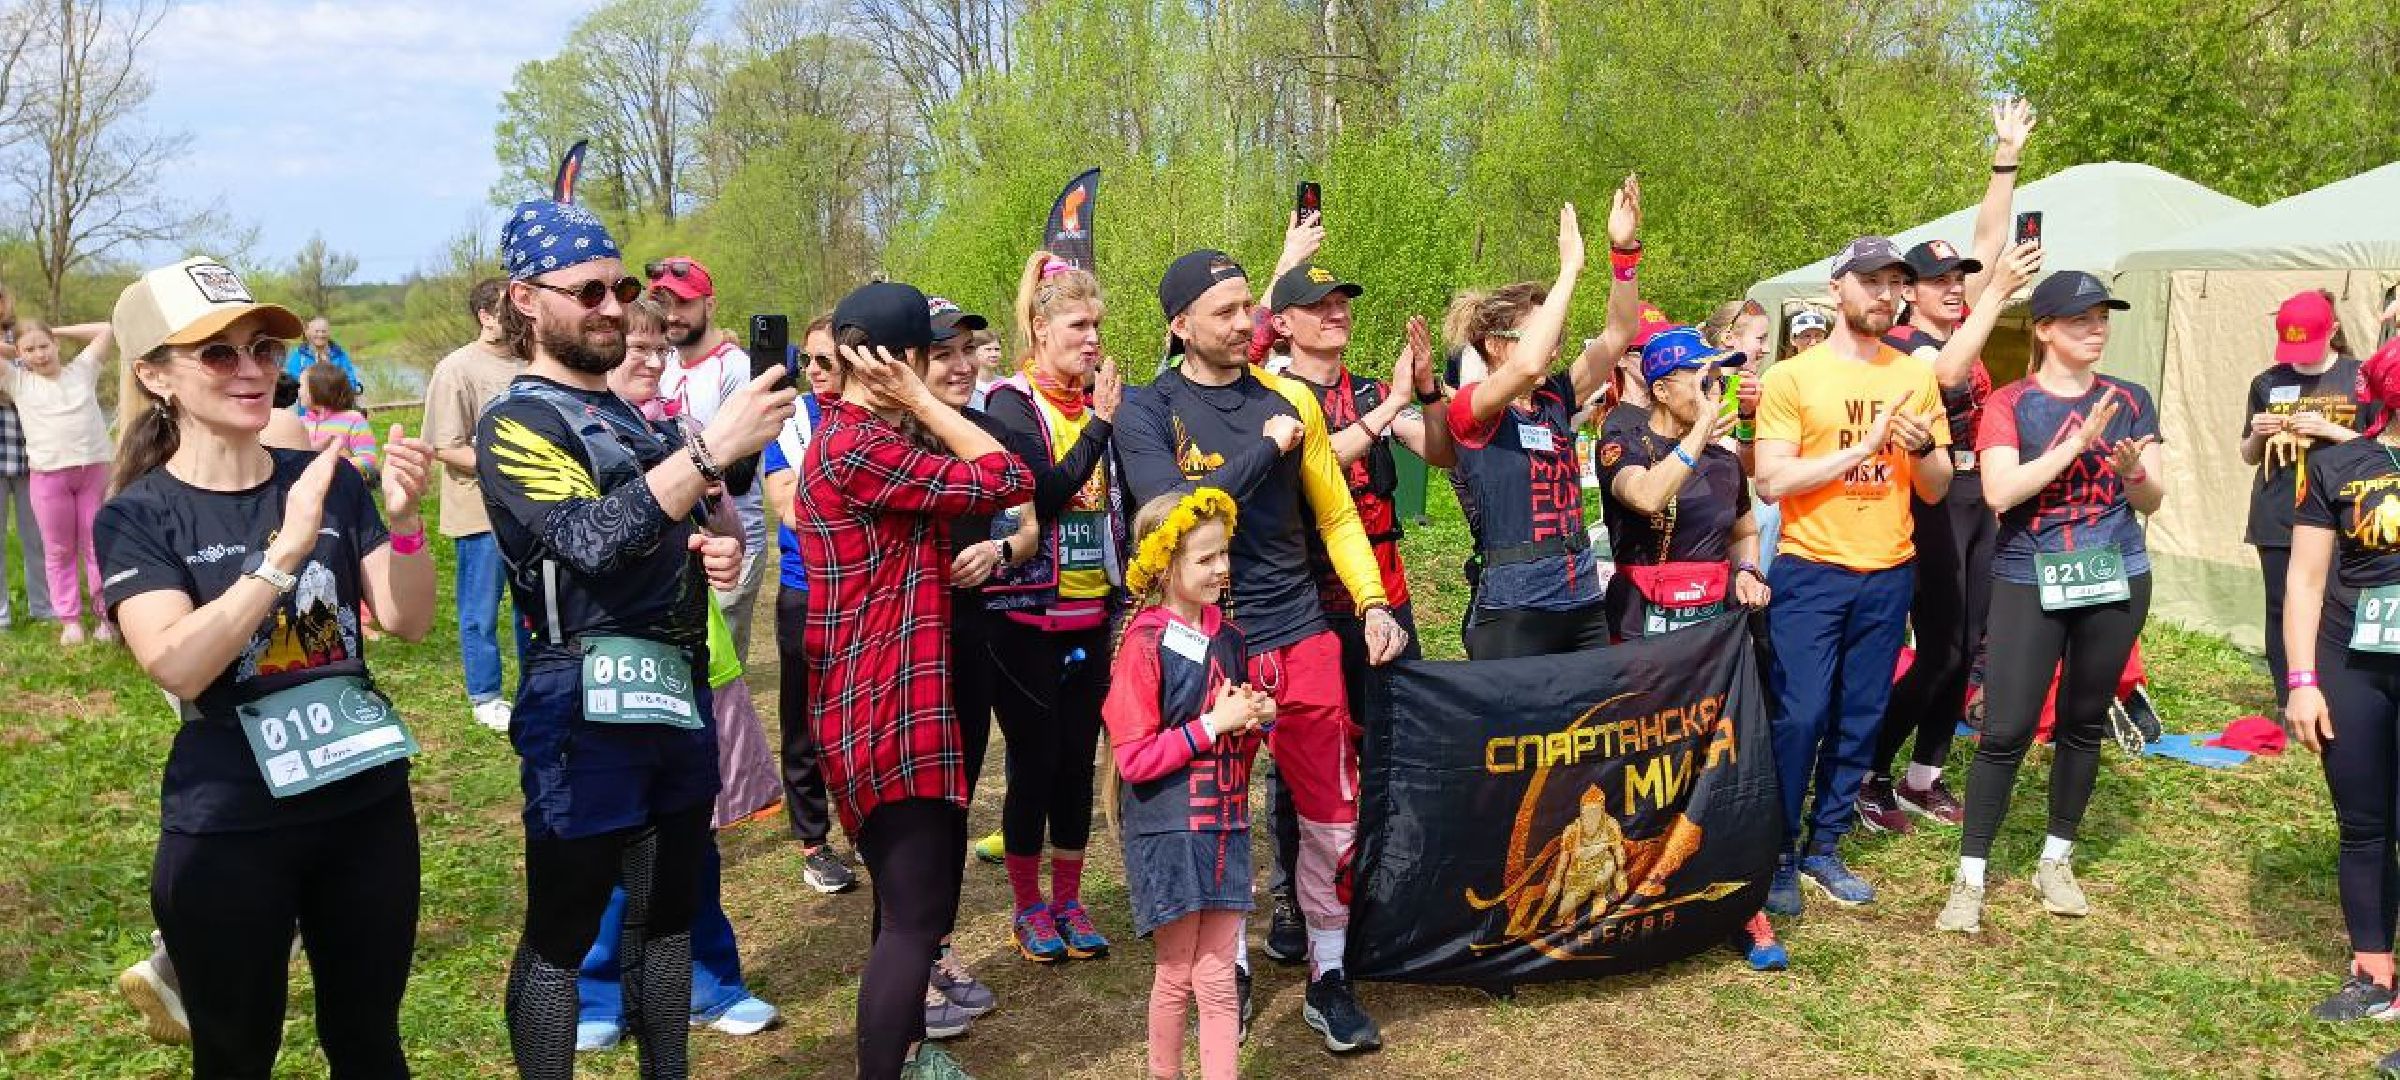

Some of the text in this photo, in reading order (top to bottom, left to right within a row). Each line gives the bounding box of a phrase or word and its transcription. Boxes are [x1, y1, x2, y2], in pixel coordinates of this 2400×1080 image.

[1844, 464, 1886, 481] MSK
[2044, 560, 2086, 583] 021
[594, 655, 657, 684] 068
[260, 702, 334, 751] 010
